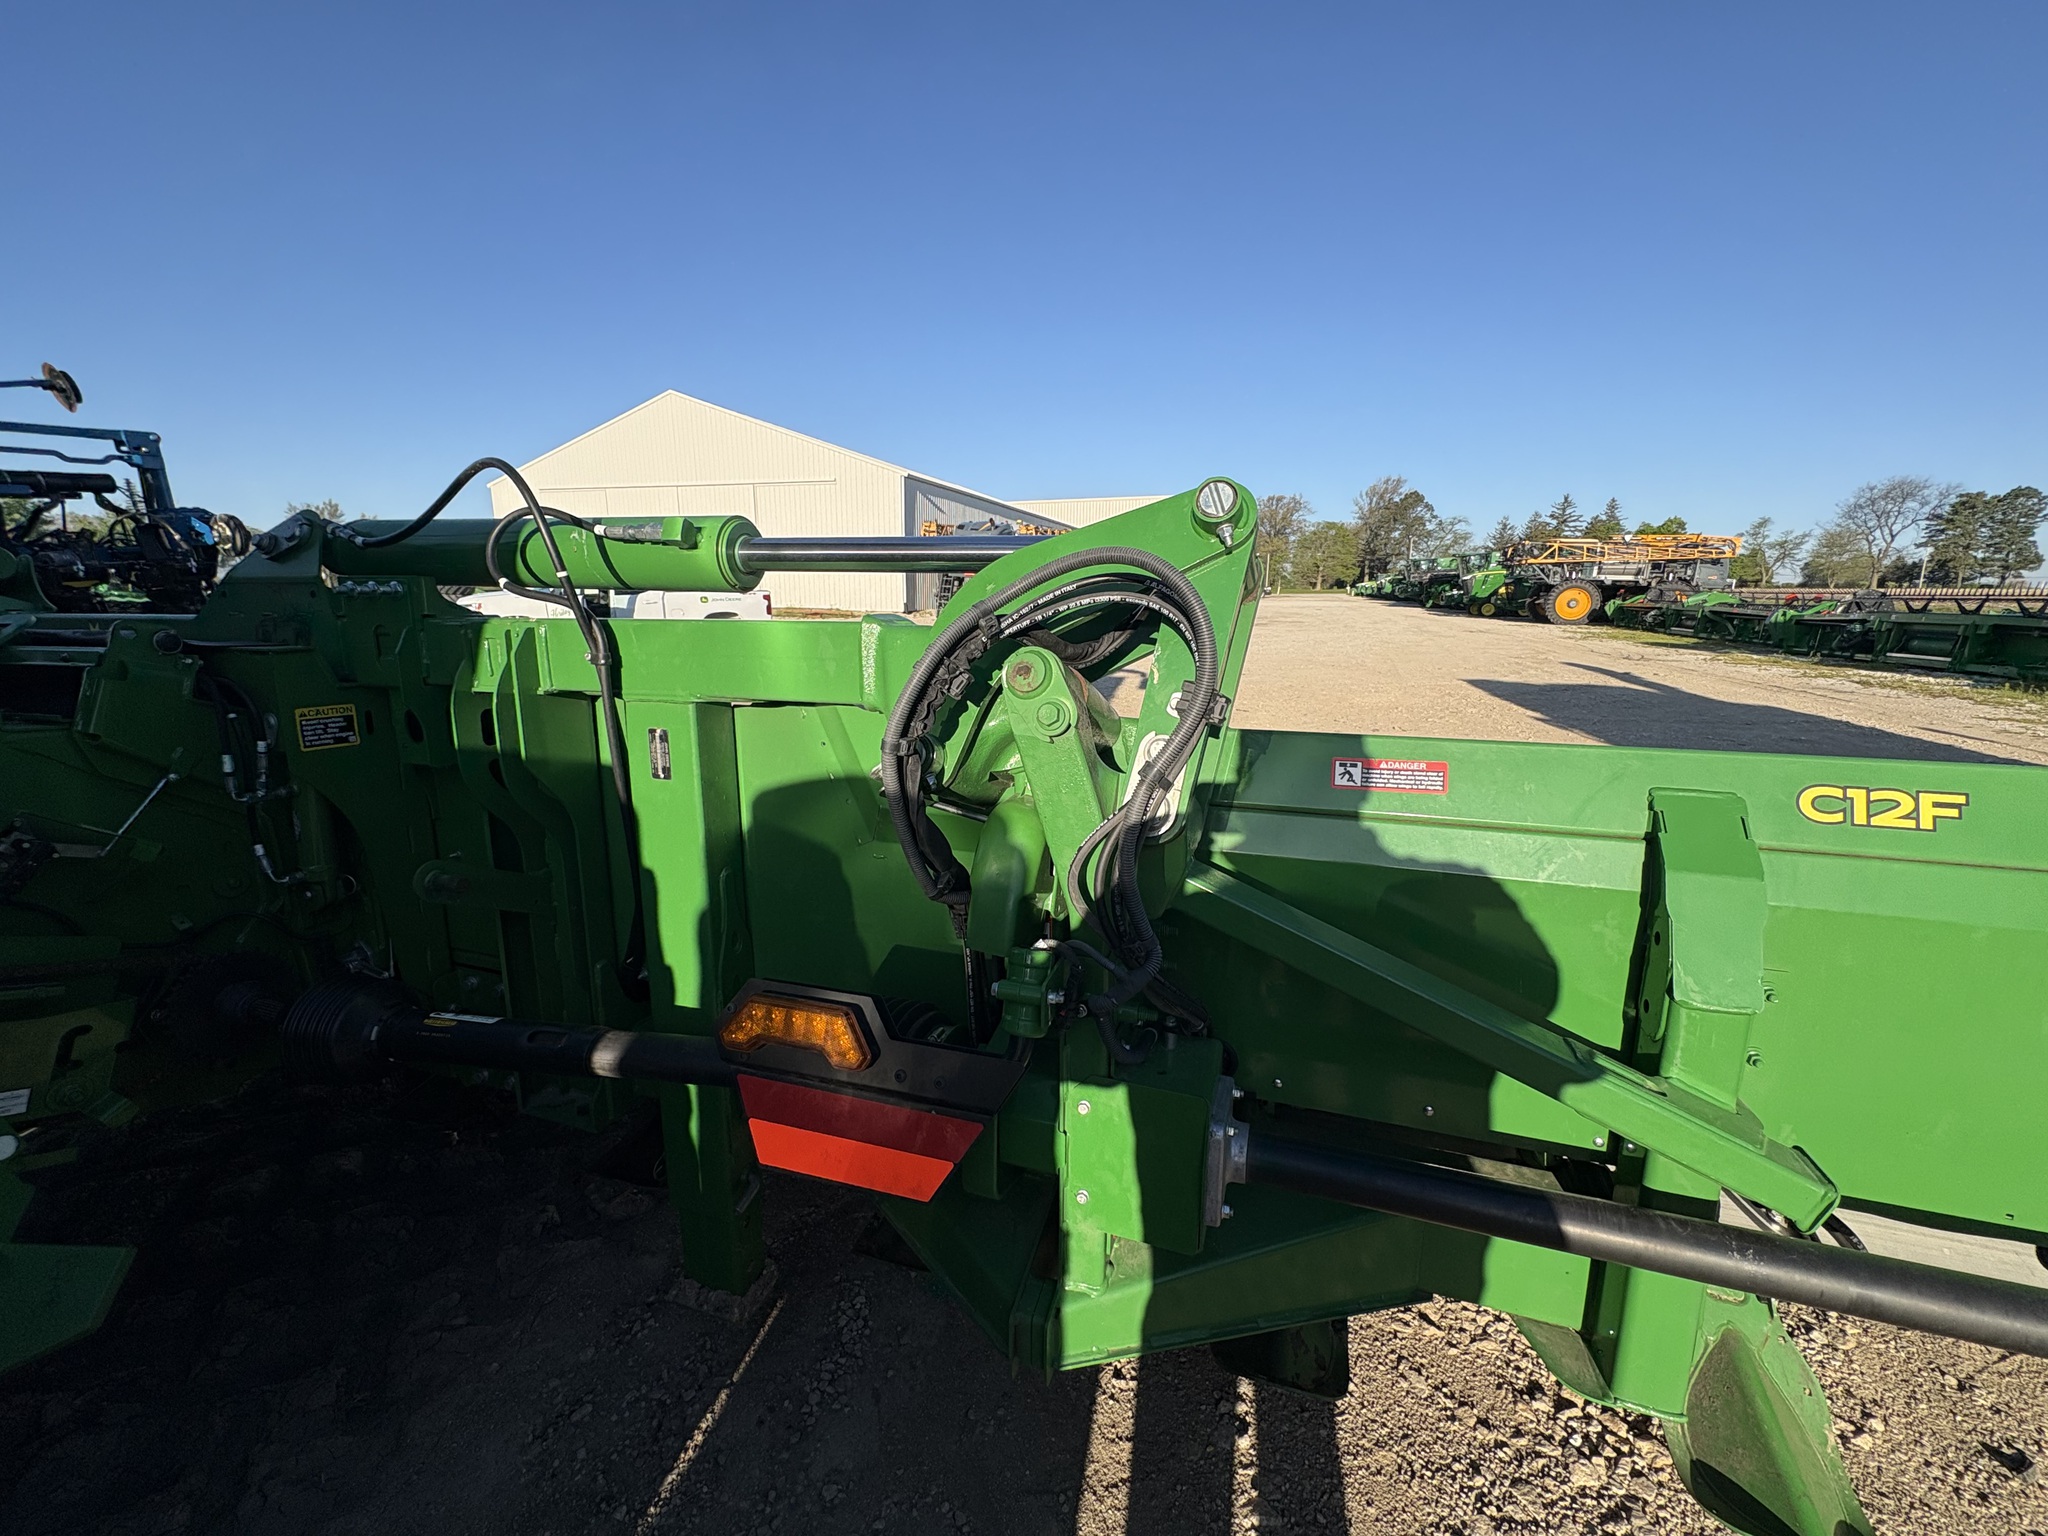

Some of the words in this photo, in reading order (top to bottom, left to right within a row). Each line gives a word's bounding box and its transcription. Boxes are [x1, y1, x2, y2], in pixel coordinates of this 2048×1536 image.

[1038, 592, 1054, 606] MADE
[1054, 589, 1062, 597] IN
[1062, 584, 1078, 594] ITALY
[1000, 620, 1031, 639] UPERTUFF
[1149, 602, 1160, 611] SAE
[308, 706, 352, 716] CAUTION
[1388, 762, 1426, 770] DANGER
[1796, 784, 1970, 832] C12F
